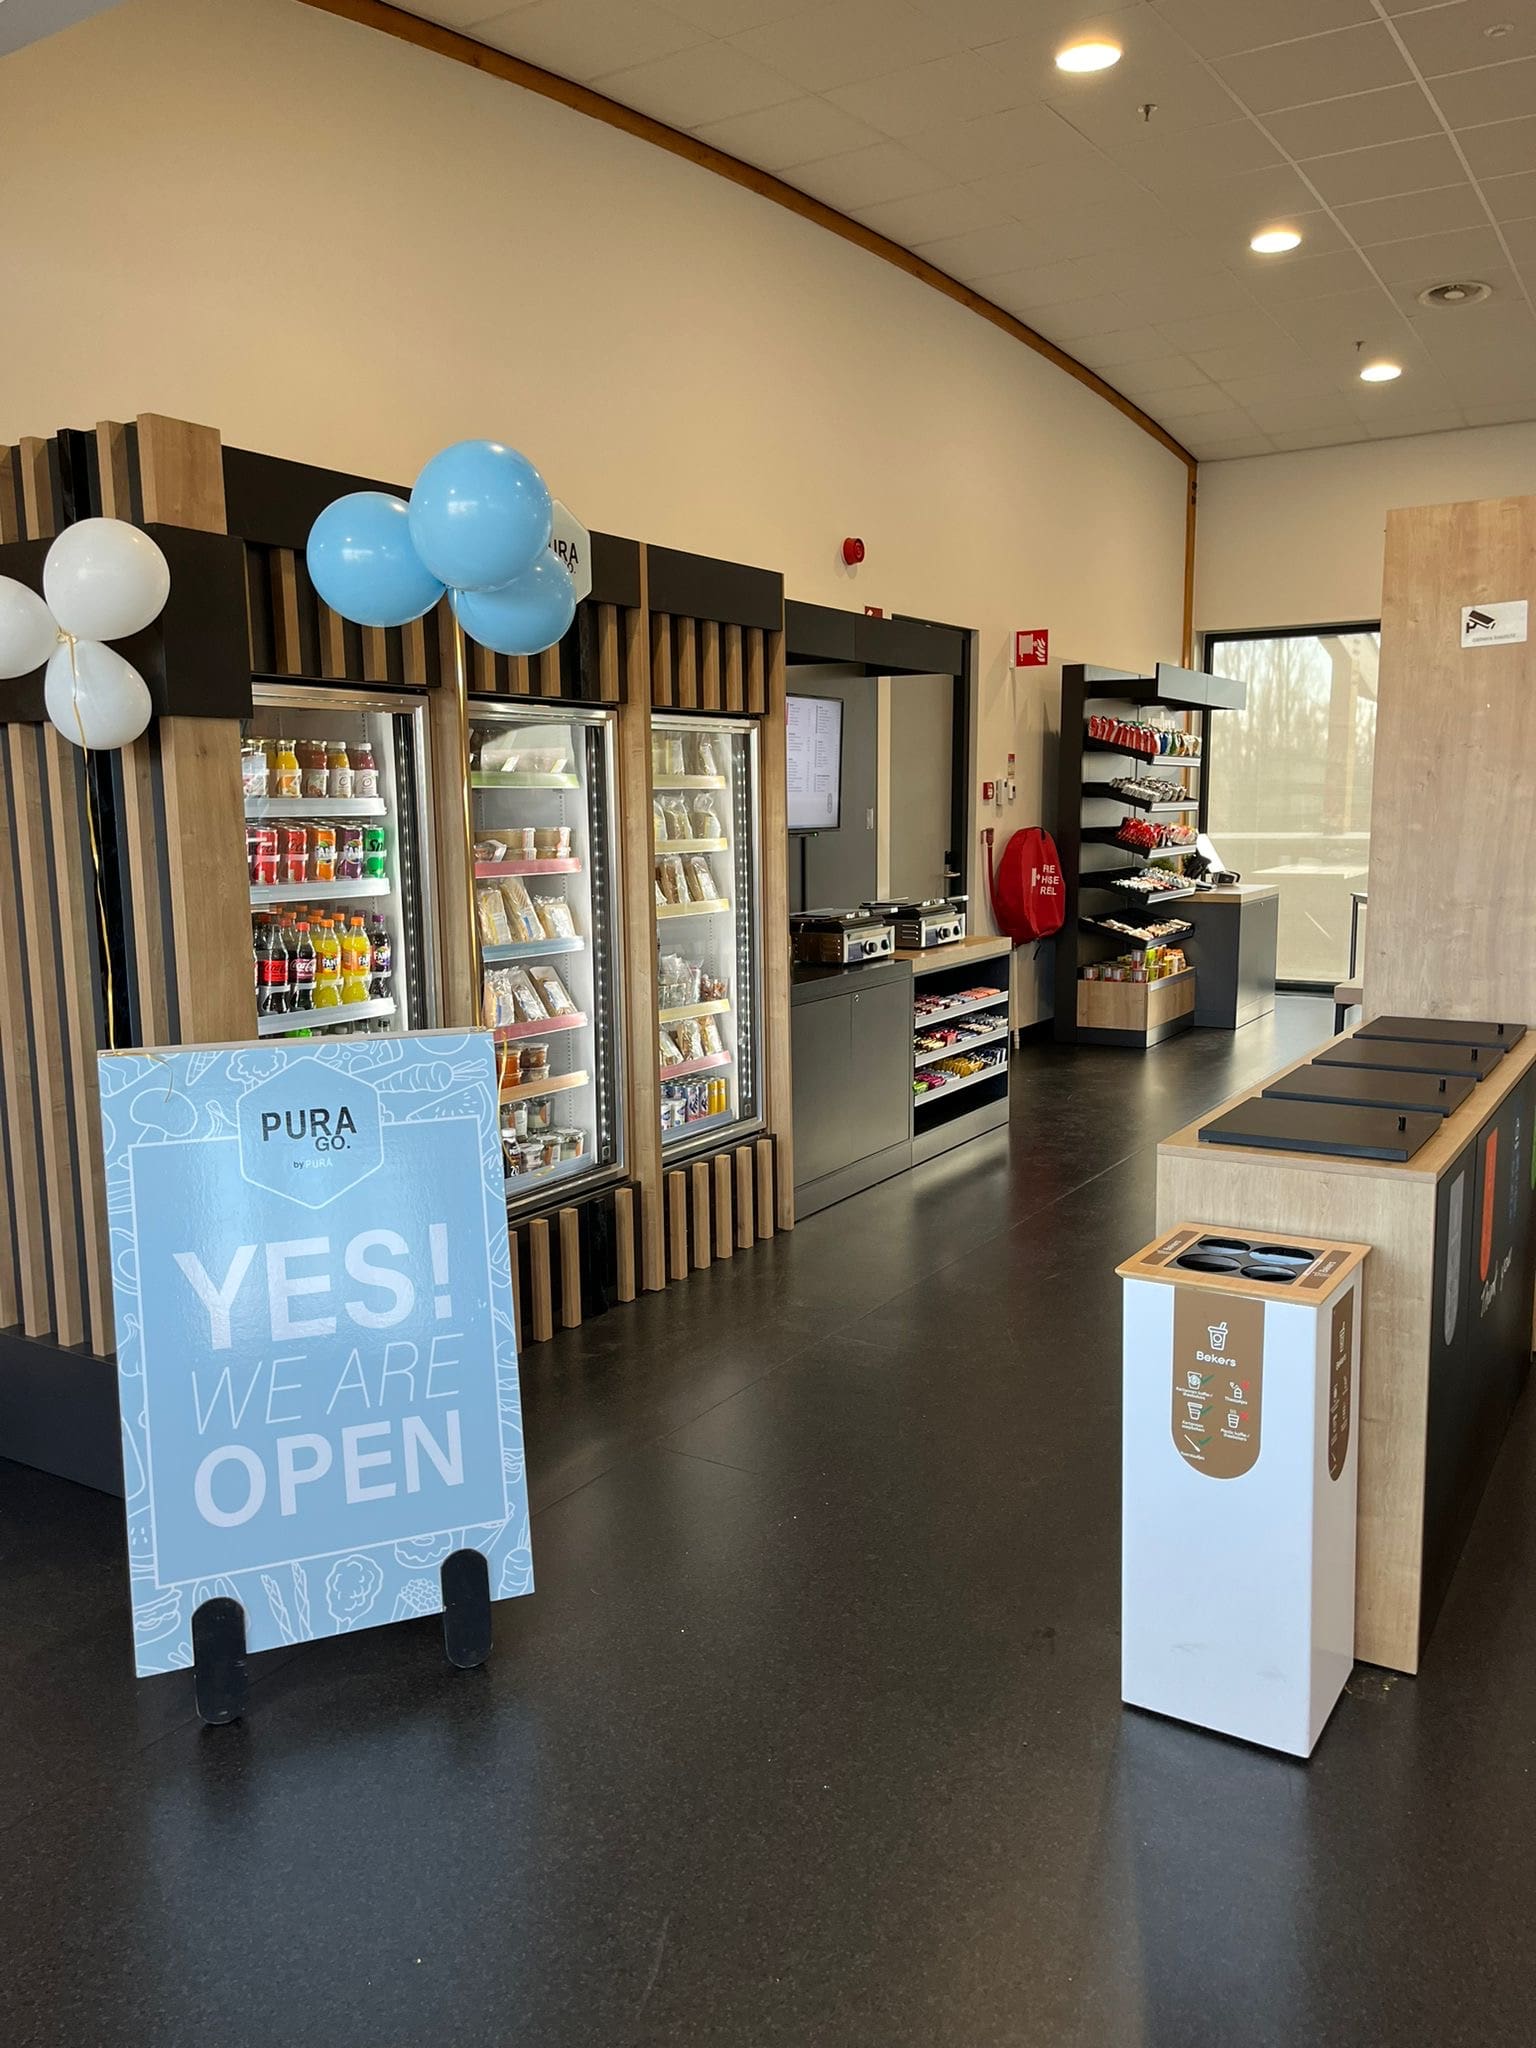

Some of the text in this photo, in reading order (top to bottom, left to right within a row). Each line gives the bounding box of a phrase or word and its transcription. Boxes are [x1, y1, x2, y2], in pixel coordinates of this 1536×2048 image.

[261, 1106, 357, 1141] PURA
[315, 1135, 351, 1152] GO.
[293, 1157, 333, 1169] by PURA
[172, 1222, 453, 1350] YES!
[1196, 1351, 1237, 1367] Bekers
[191, 1333, 464, 1435] WE ARE
[194, 1409, 465, 1527] OPEN
